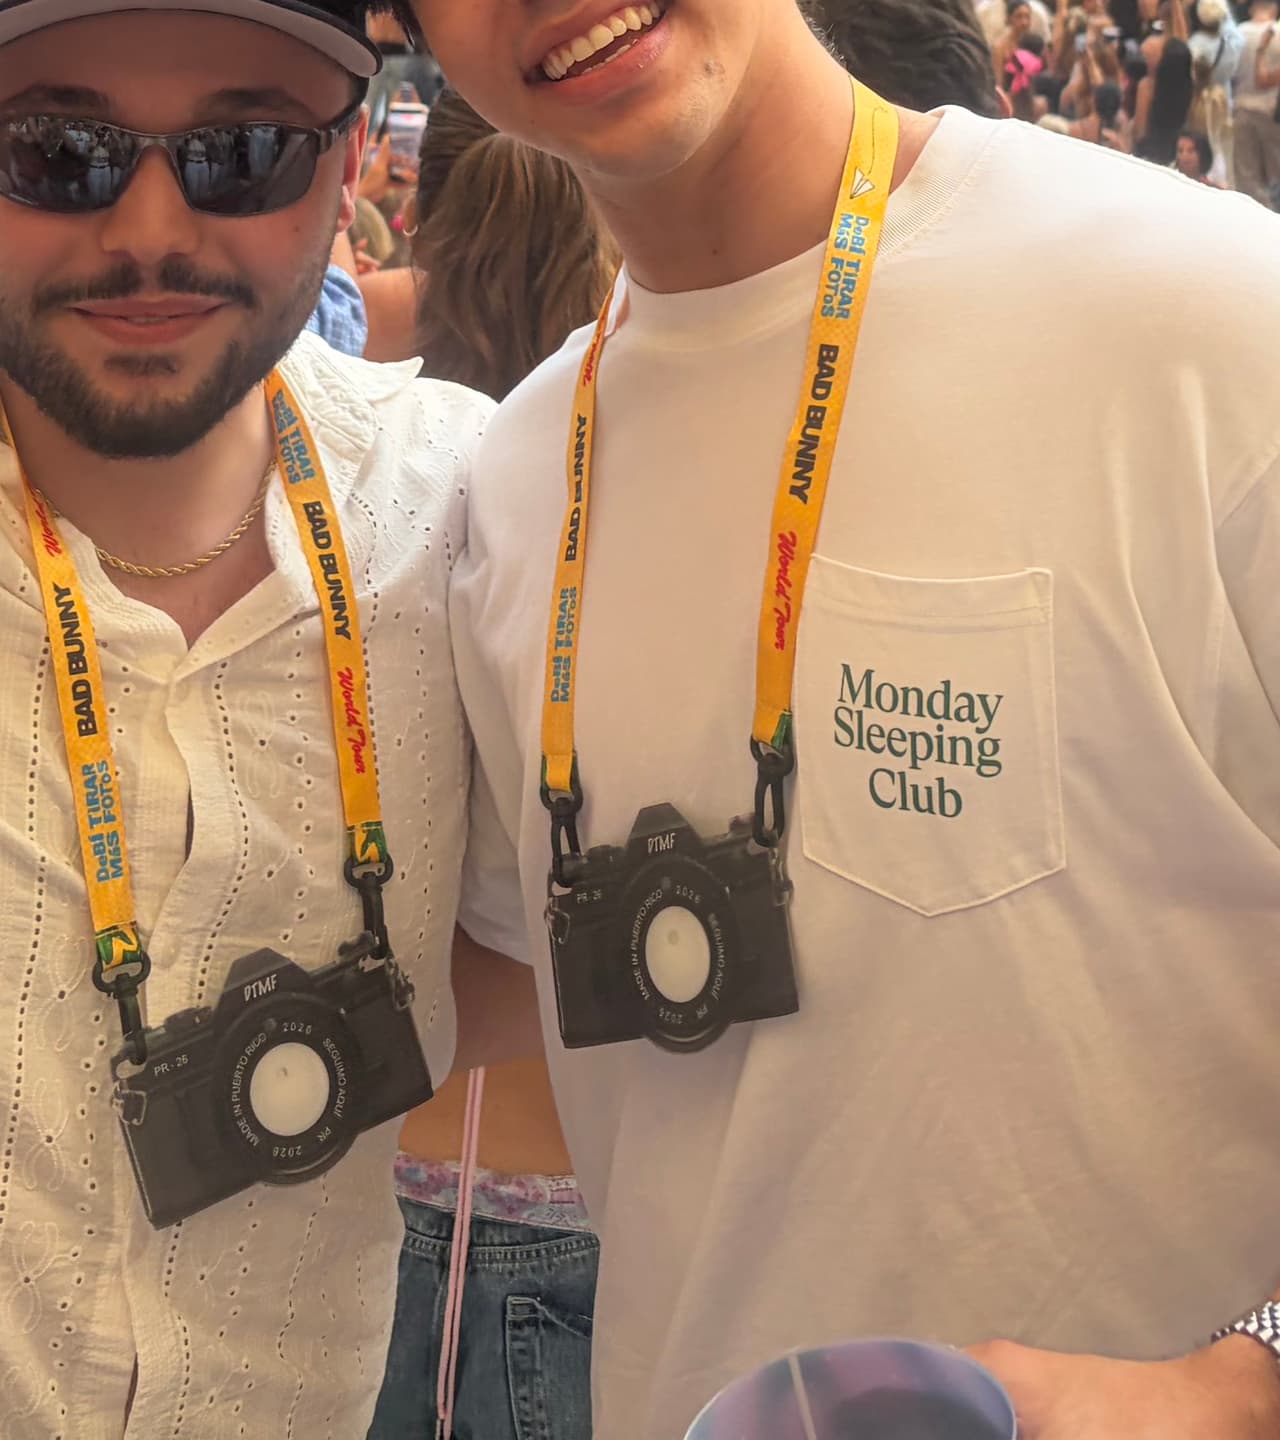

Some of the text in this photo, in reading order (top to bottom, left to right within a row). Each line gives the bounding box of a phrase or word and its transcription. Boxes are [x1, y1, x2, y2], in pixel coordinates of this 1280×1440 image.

[789, 344, 839, 505] BAD BUNNY
[565, 507, 580, 562] BAD
[303, 500, 351, 640] BAD BUNNY
[53, 581, 98, 738] BAD BUNNY
[337, 666, 361, 728] World
[837, 663, 1004, 735] Monday
[834, 706, 1003, 778] Sleeping
[869, 767, 963, 818] Club
[647, 832, 677, 854] DTMF
[243, 974, 278, 1002] DTMF
[232, 1032, 267, 1146] MADE IN PUERTO RICO
[317, 1126, 331, 1142] PR
